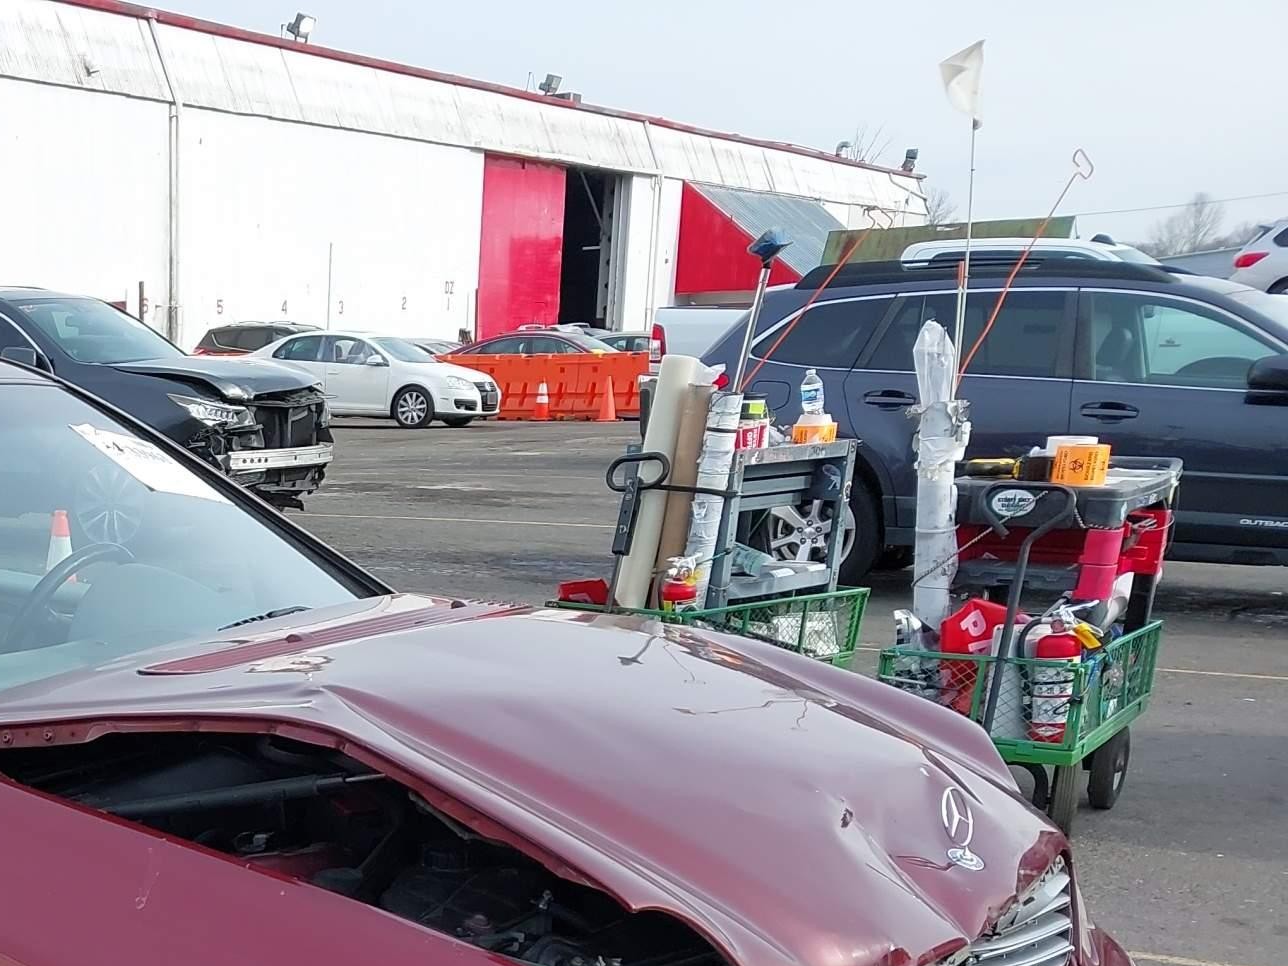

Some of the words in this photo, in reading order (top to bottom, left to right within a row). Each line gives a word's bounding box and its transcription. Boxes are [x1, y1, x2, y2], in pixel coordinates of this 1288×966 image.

[216, 299, 224, 315] 5
[281, 299, 288, 315] 4
[401, 296, 407, 310] 2
